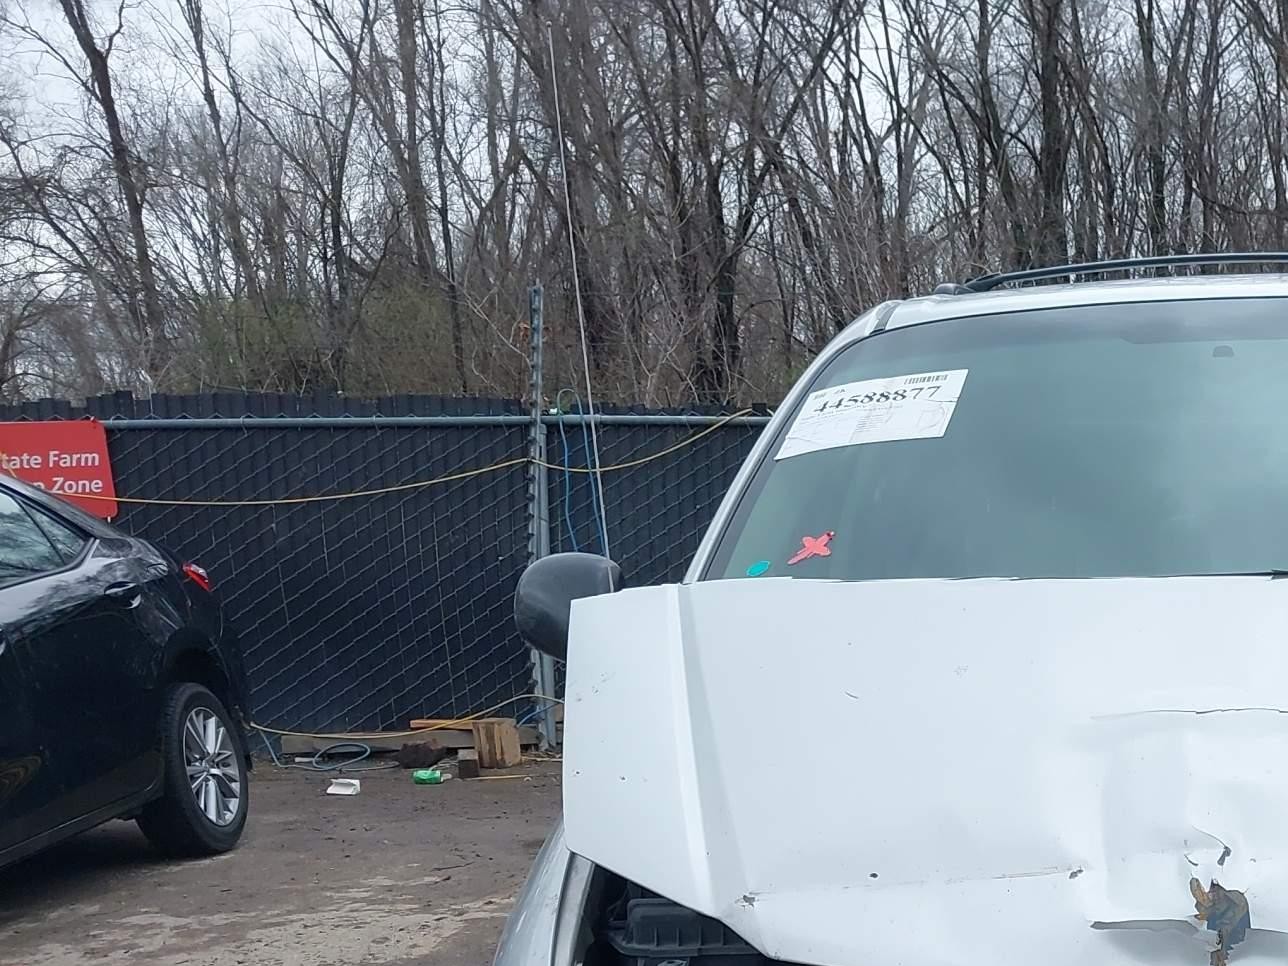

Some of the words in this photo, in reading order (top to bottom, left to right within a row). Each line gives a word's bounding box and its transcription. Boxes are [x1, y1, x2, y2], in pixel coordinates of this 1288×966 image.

[813, 385, 942, 413] 44588877
[0, 453, 42, 469] tate
[48, 450, 100, 468] Farm
[51, 477, 103, 494] Zone
